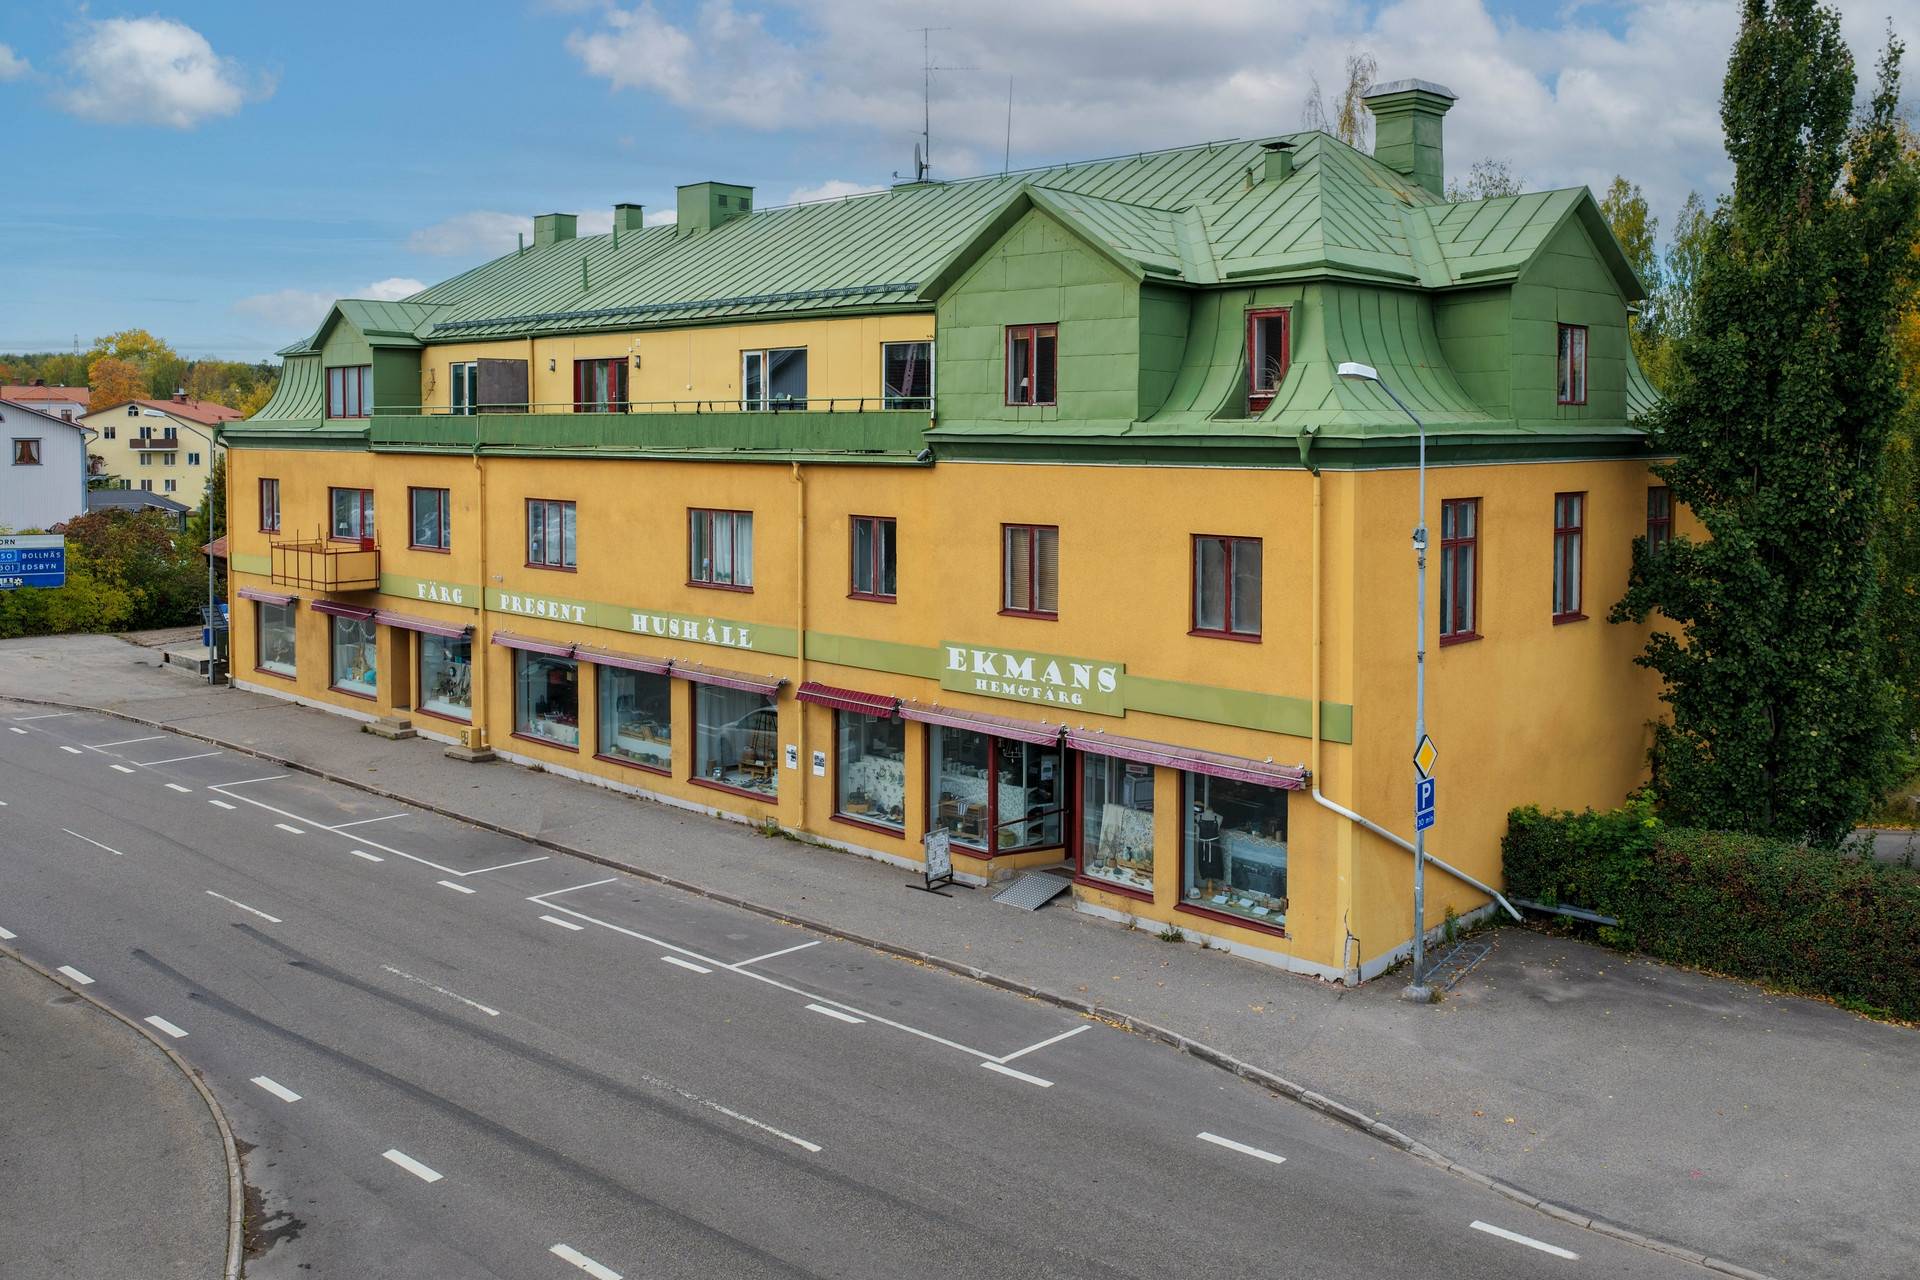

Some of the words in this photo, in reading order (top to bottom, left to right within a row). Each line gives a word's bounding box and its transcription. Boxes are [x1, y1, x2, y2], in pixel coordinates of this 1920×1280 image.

[22, 550, 61, 559] BOLLNÄS
[22, 563, 57, 571] EDSBYN
[417, 581, 463, 604] FÄRG
[500, 593, 587, 623] PRESENT
[631, 613, 753, 648] HUSHÅLL
[945, 646, 1117, 693] EKMANS
[1422, 782, 1431, 809] P
